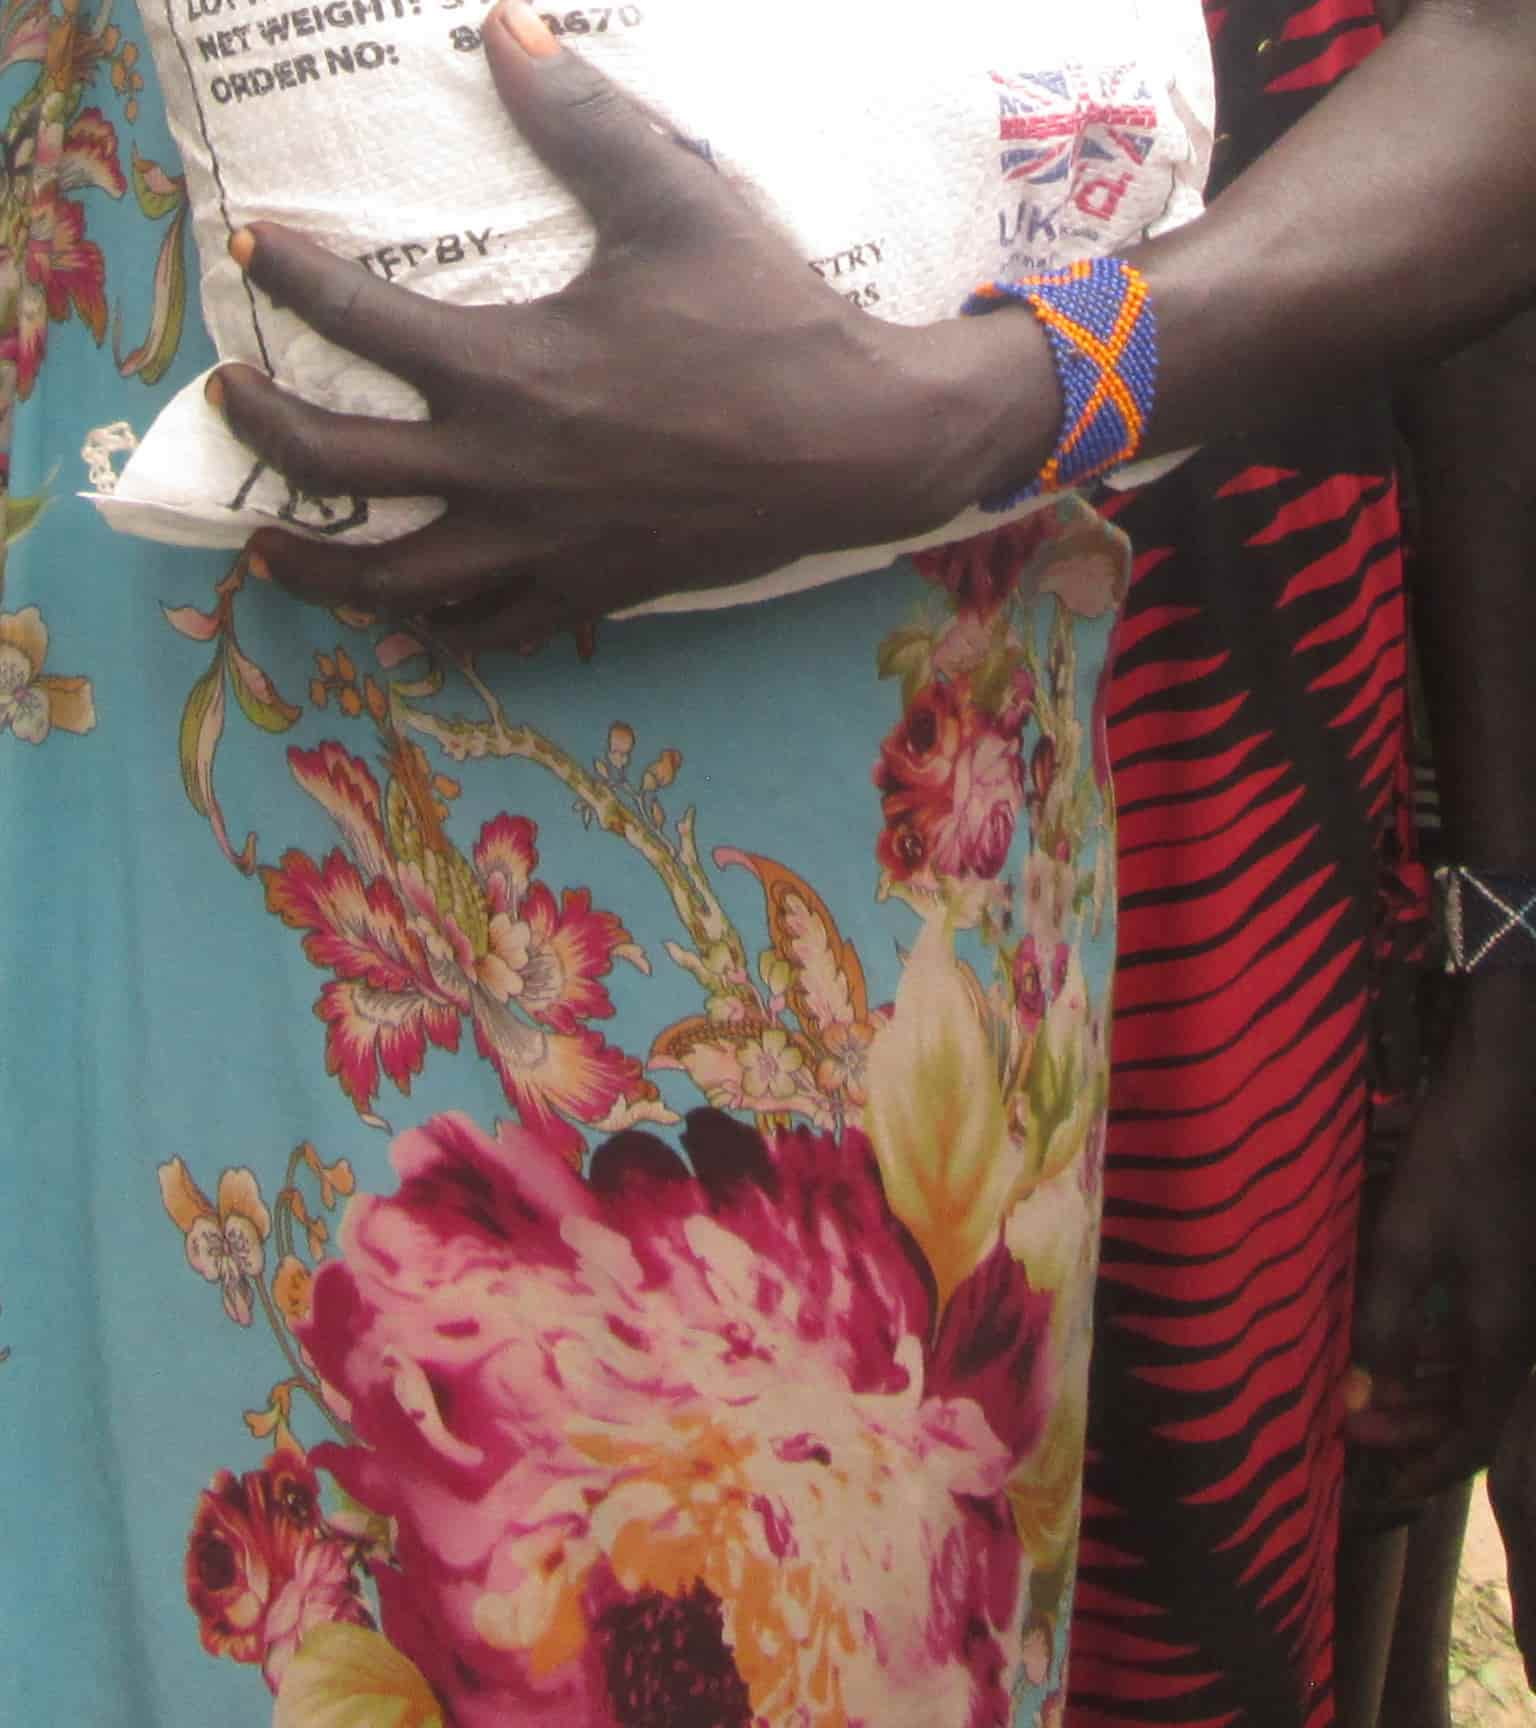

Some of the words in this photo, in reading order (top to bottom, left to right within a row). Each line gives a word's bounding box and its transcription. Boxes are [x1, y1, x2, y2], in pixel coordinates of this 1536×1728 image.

[195, 19, 251, 65] NET
[208, 49, 322, 107] ORDER
[326, 39, 401, 78] NO:
